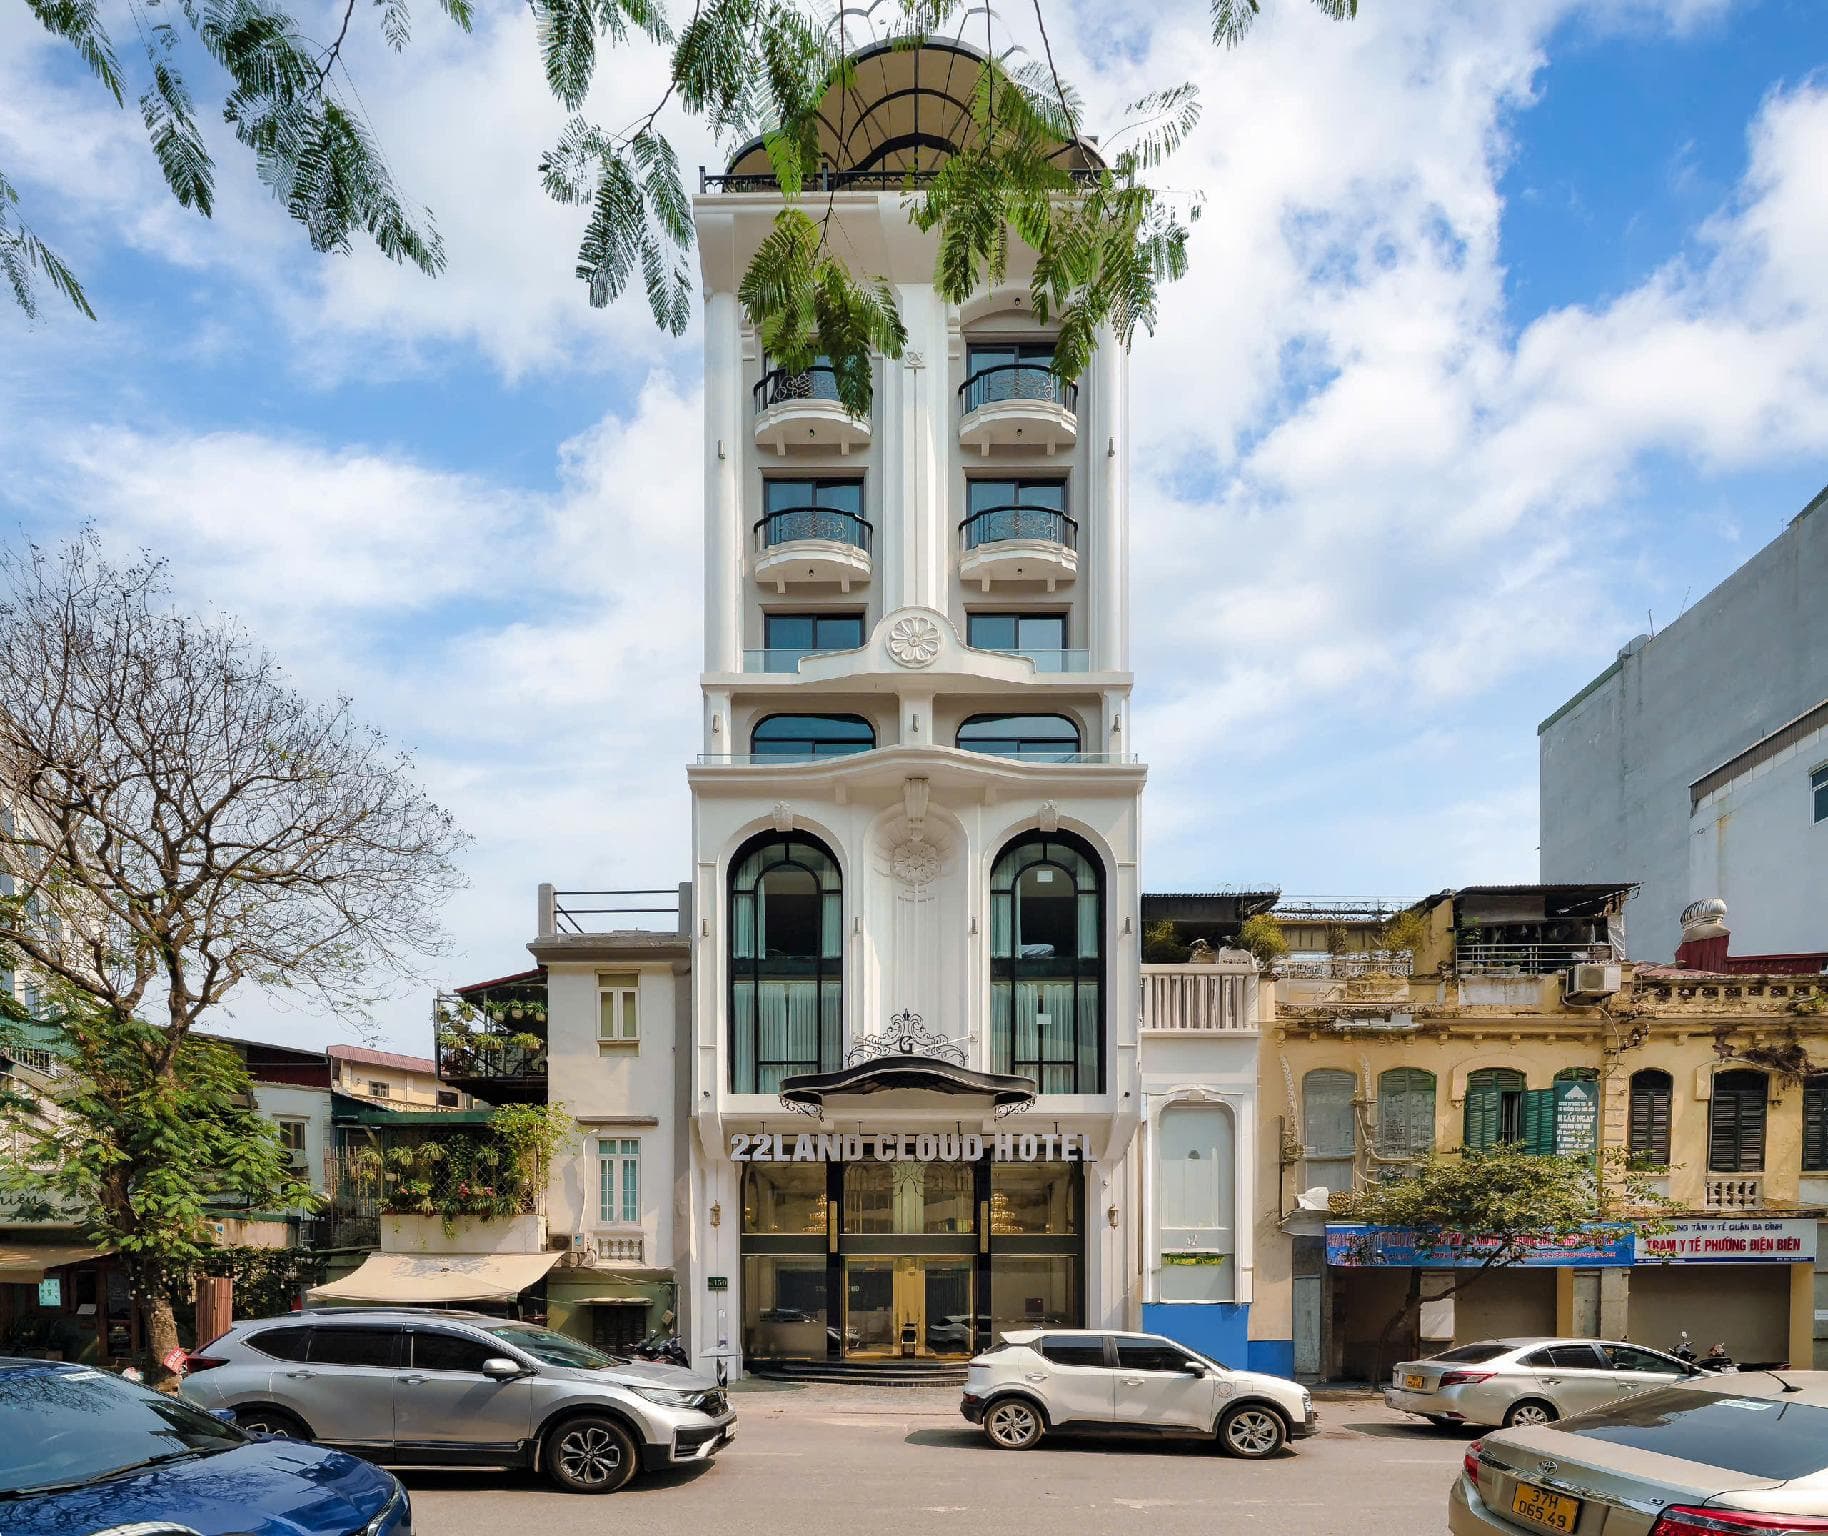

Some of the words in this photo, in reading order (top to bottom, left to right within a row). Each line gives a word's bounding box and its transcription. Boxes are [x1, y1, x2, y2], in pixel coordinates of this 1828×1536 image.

[731, 1133, 864, 1162] 22LAND
[874, 1133, 984, 1162] CLOUD
[994, 1133, 1097, 1162] HOTEL
[1679, 1239, 1687, 1252] Y
[1689, 1235, 1702, 1252] TẾ
[1531, 1490, 1559, 1510] 37H
[1518, 1500, 1567, 1528] 065.49
